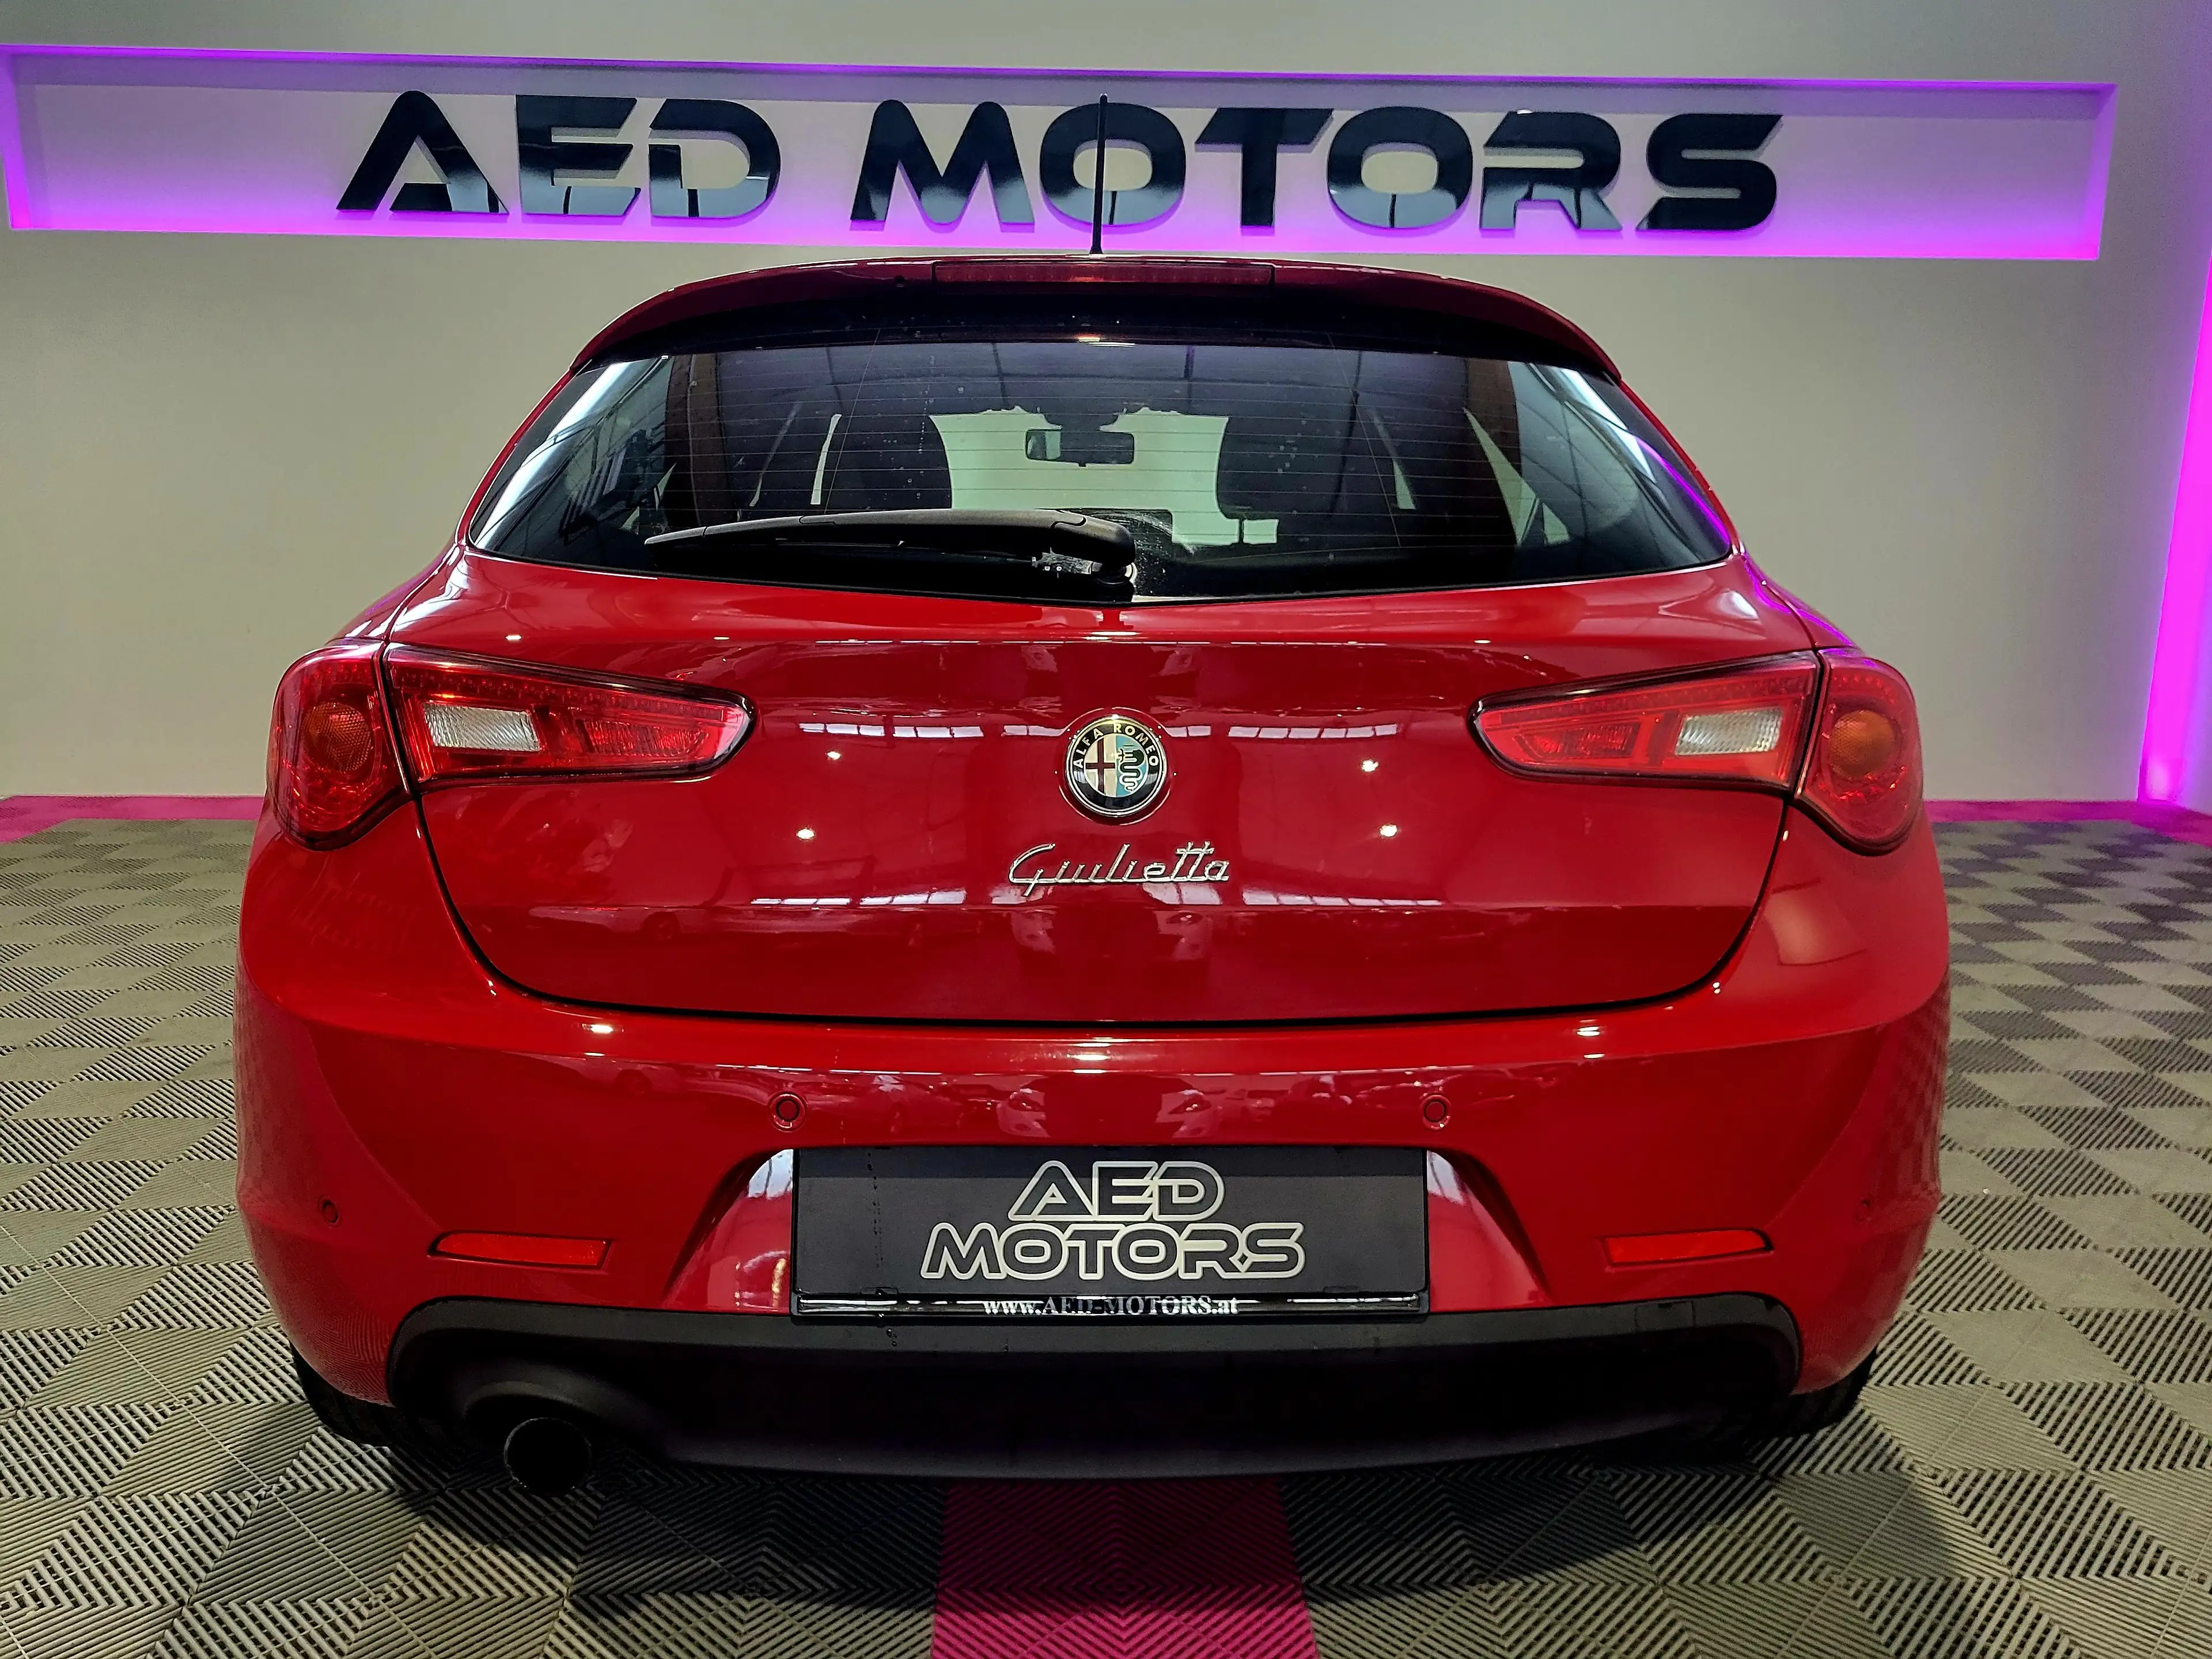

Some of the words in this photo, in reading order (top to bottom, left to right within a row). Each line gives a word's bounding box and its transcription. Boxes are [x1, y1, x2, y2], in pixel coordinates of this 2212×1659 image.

[336, 90, 781, 220] AED
[850, 99, 1783, 232] MOTORS
[1073, 728, 1104, 769] ALFA
[1113, 722, 1159, 767] ROMEO
[1008, 841, 1230, 897] Giulietta
[1007, 1160, 1225, 1222] AED
[920, 1222, 1306, 1281] MOTORS
[983, 1296, 1241, 1316] www.AED-MOTORS.at
